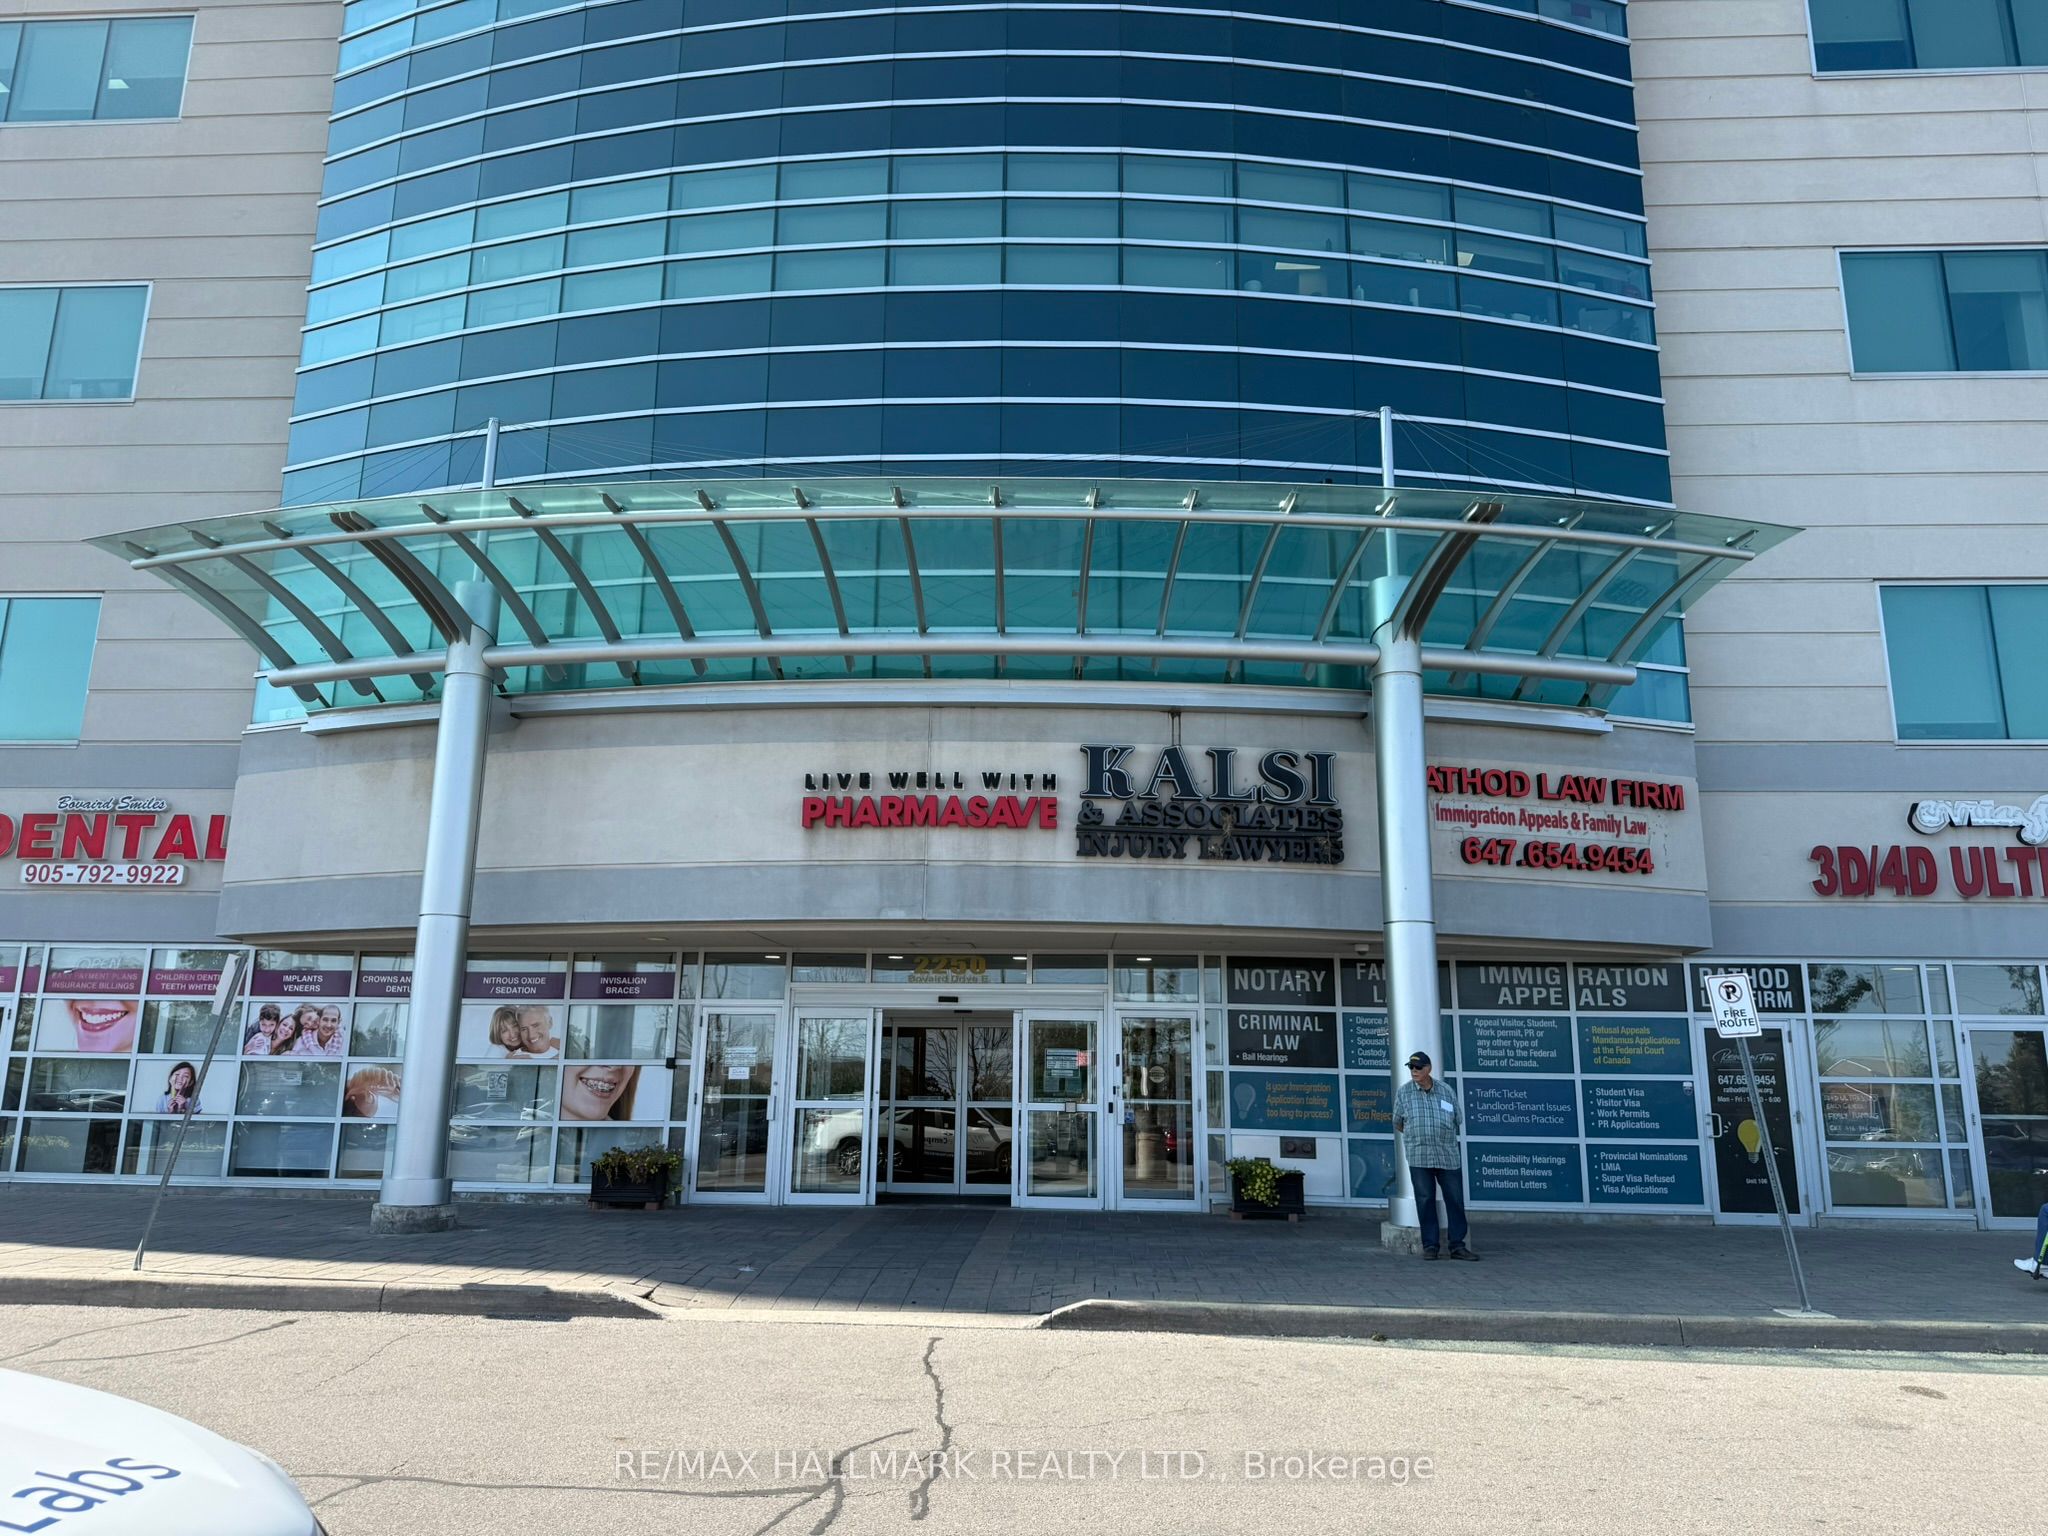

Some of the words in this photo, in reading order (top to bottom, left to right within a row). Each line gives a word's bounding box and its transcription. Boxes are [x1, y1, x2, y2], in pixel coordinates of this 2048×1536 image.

[1080, 744, 1338, 806] KALSI
[805, 772, 872, 791] LIVE
[888, 772, 965, 791] WELL
[982, 772, 1058, 792] WITH
[1537, 772, 1607, 804] LAW
[1612, 779, 1685, 811] FIRM
[58, 796, 113, 810] Bovaird
[118, 796, 166, 810] Smiles
[801, 795, 1058, 829] PHARMASAVE
[1078, 800, 1105, 824] &
[1116, 801, 1344, 831] ASSOCIATES
[1435, 803, 1516, 828] Immigration
[1519, 808, 1568, 832] Appeals
[1571, 814, 1581, 831] &
[1583, 814, 1622, 838] Family
[1624, 816, 1647, 835] Law
[1076, 831, 1190, 859] INJURY
[1198, 834, 1345, 865] LAWYERS
[1461, 836, 1655, 874] 647.654.9454
[25, 864, 178, 884] 905-792-9922
[1808, 845, 1938, 897] 3D/4D
[913, 956, 986, 975] 2250
[155, 973, 196, 981] CHILDREN
[1356, 963, 1387, 981] FA
[283, 975, 323, 983] IMPLANTS
[362, 975, 399, 983] CROWNS
[483, 976, 519, 984] NITROUS
[521, 976, 546, 985] OXIDE
[600, 976, 647, 985] INVISALIGN
[908, 975, 947, 984] Bovaird
[1234, 968, 1326, 992] NOTARY
[52, 981, 97, 989] INSURANCE
[99, 982, 135, 990] BILLINGS
[161, 982, 186, 991] TEETH
[283, 984, 320, 993] VENEERS
[495, 986, 537, 994] SEDATION
[606, 986, 641, 994] BRACES
[1723, 1009, 1747, 1018] FIRE
[1239, 1014, 1324, 1032] CRIMINAL
[1356, 1016, 1382, 1025] Divorce
[1474, 1018, 1499, 1028] Appeal
[1720, 1018, 1755, 1028] ROUTE
[1475, 1028, 1495, 1036] Work
[1524, 1029, 1534, 1037] PR
[1592, 1026, 1620, 1034] Refusal
[1621, 1026, 1650, 1035] Appeals
[1263, 1034, 1300, 1051] LAW
[1357, 1037, 1385, 1047] Spousal
[1513, 1039, 1529, 1048] type
[1530, 1039, 1538, 1047] of
[1592, 1036, 1634, 1044] Mandamus
[1635, 1036, 1681, 1045] Applications
[1357, 1048, 1387, 1057] Custody
[1477, 1048, 1505, 1056] Refusal
[1507, 1049, 1515, 1057] to
[1516, 1049, 1528, 1057] the
[1529, 1049, 1557, 1058] Federal
[1593, 1046, 1600, 1054] at
[1602, 1046, 1614, 1054] the
[1616, 1046, 1642, 1054] Federal
[1644, 1046, 1665, 1055] Court
[1242, 1052, 1256, 1061] Bail
[1257, 1053, 1289, 1063] Hearings
[1358, 1058, 1391, 1066] Domestic
[1478, 1058, 1499, 1066] Court
[1500, 1058, 1508, 1066] of
[1593, 1056, 1601, 1064] of
[1602, 1056, 1631, 1065] Canada
[1718, 1075, 1776, 1085] 647.659454
[1475, 1088, 1501, 1098] Traffic
[1502, 1089, 1527, 1099] Ticket
[1595, 1088, 1626, 1096] Student
[1627, 1088, 1645, 1097] Visa
[1266, 1094, 1304, 1106] Application
[1596, 1098, 1621, 1107] Visitor
[1623, 1098, 1640, 1107] Visa
[1476, 1101, 1545, 1111] Landlord-Tenant
[1546, 1102, 1571, 1112] Issues
[1267, 1108, 1278, 1117] too
[1280, 1108, 1294, 1119] long
[1353, 1109, 1370, 1120] Visa
[1477, 1113, 1500, 1122] Small
[1502, 1113, 1530, 1123] Claims
[1531, 1114, 1564, 1124] Practice
[1597, 1109, 1618, 1117] Work
[1620, 1109, 1650, 1118] Permits
[1598, 1120, 1608, 1128] PR
[1611, 1120, 1660, 1130] Applications
[1481, 1154, 1530, 1165] Admissibility
[1532, 1155, 1567, 1165] Hearings
[1600, 1152, 1638, 1160] Provincial
[1640, 1152, 1688, 1161] Nominations
[1482, 1167, 1519, 1176] Detention
[1521, 1167, 1552, 1176] Reviews
[1601, 1163, 1621, 1171] LMIA
[1602, 1173, 1624, 1183] Super
[1626, 1174, 1642, 1182] Visa
[1644, 1174, 1675, 1183] Refused
[1483, 1179, 1518, 1188] Invitation
[1520, 1180, 1548, 1189] Letters
[1603, 1184, 1619, 1193] Visa
[1621, 1185, 1668, 1195] Applications
[0, 1457, 181, 1534] Labs
